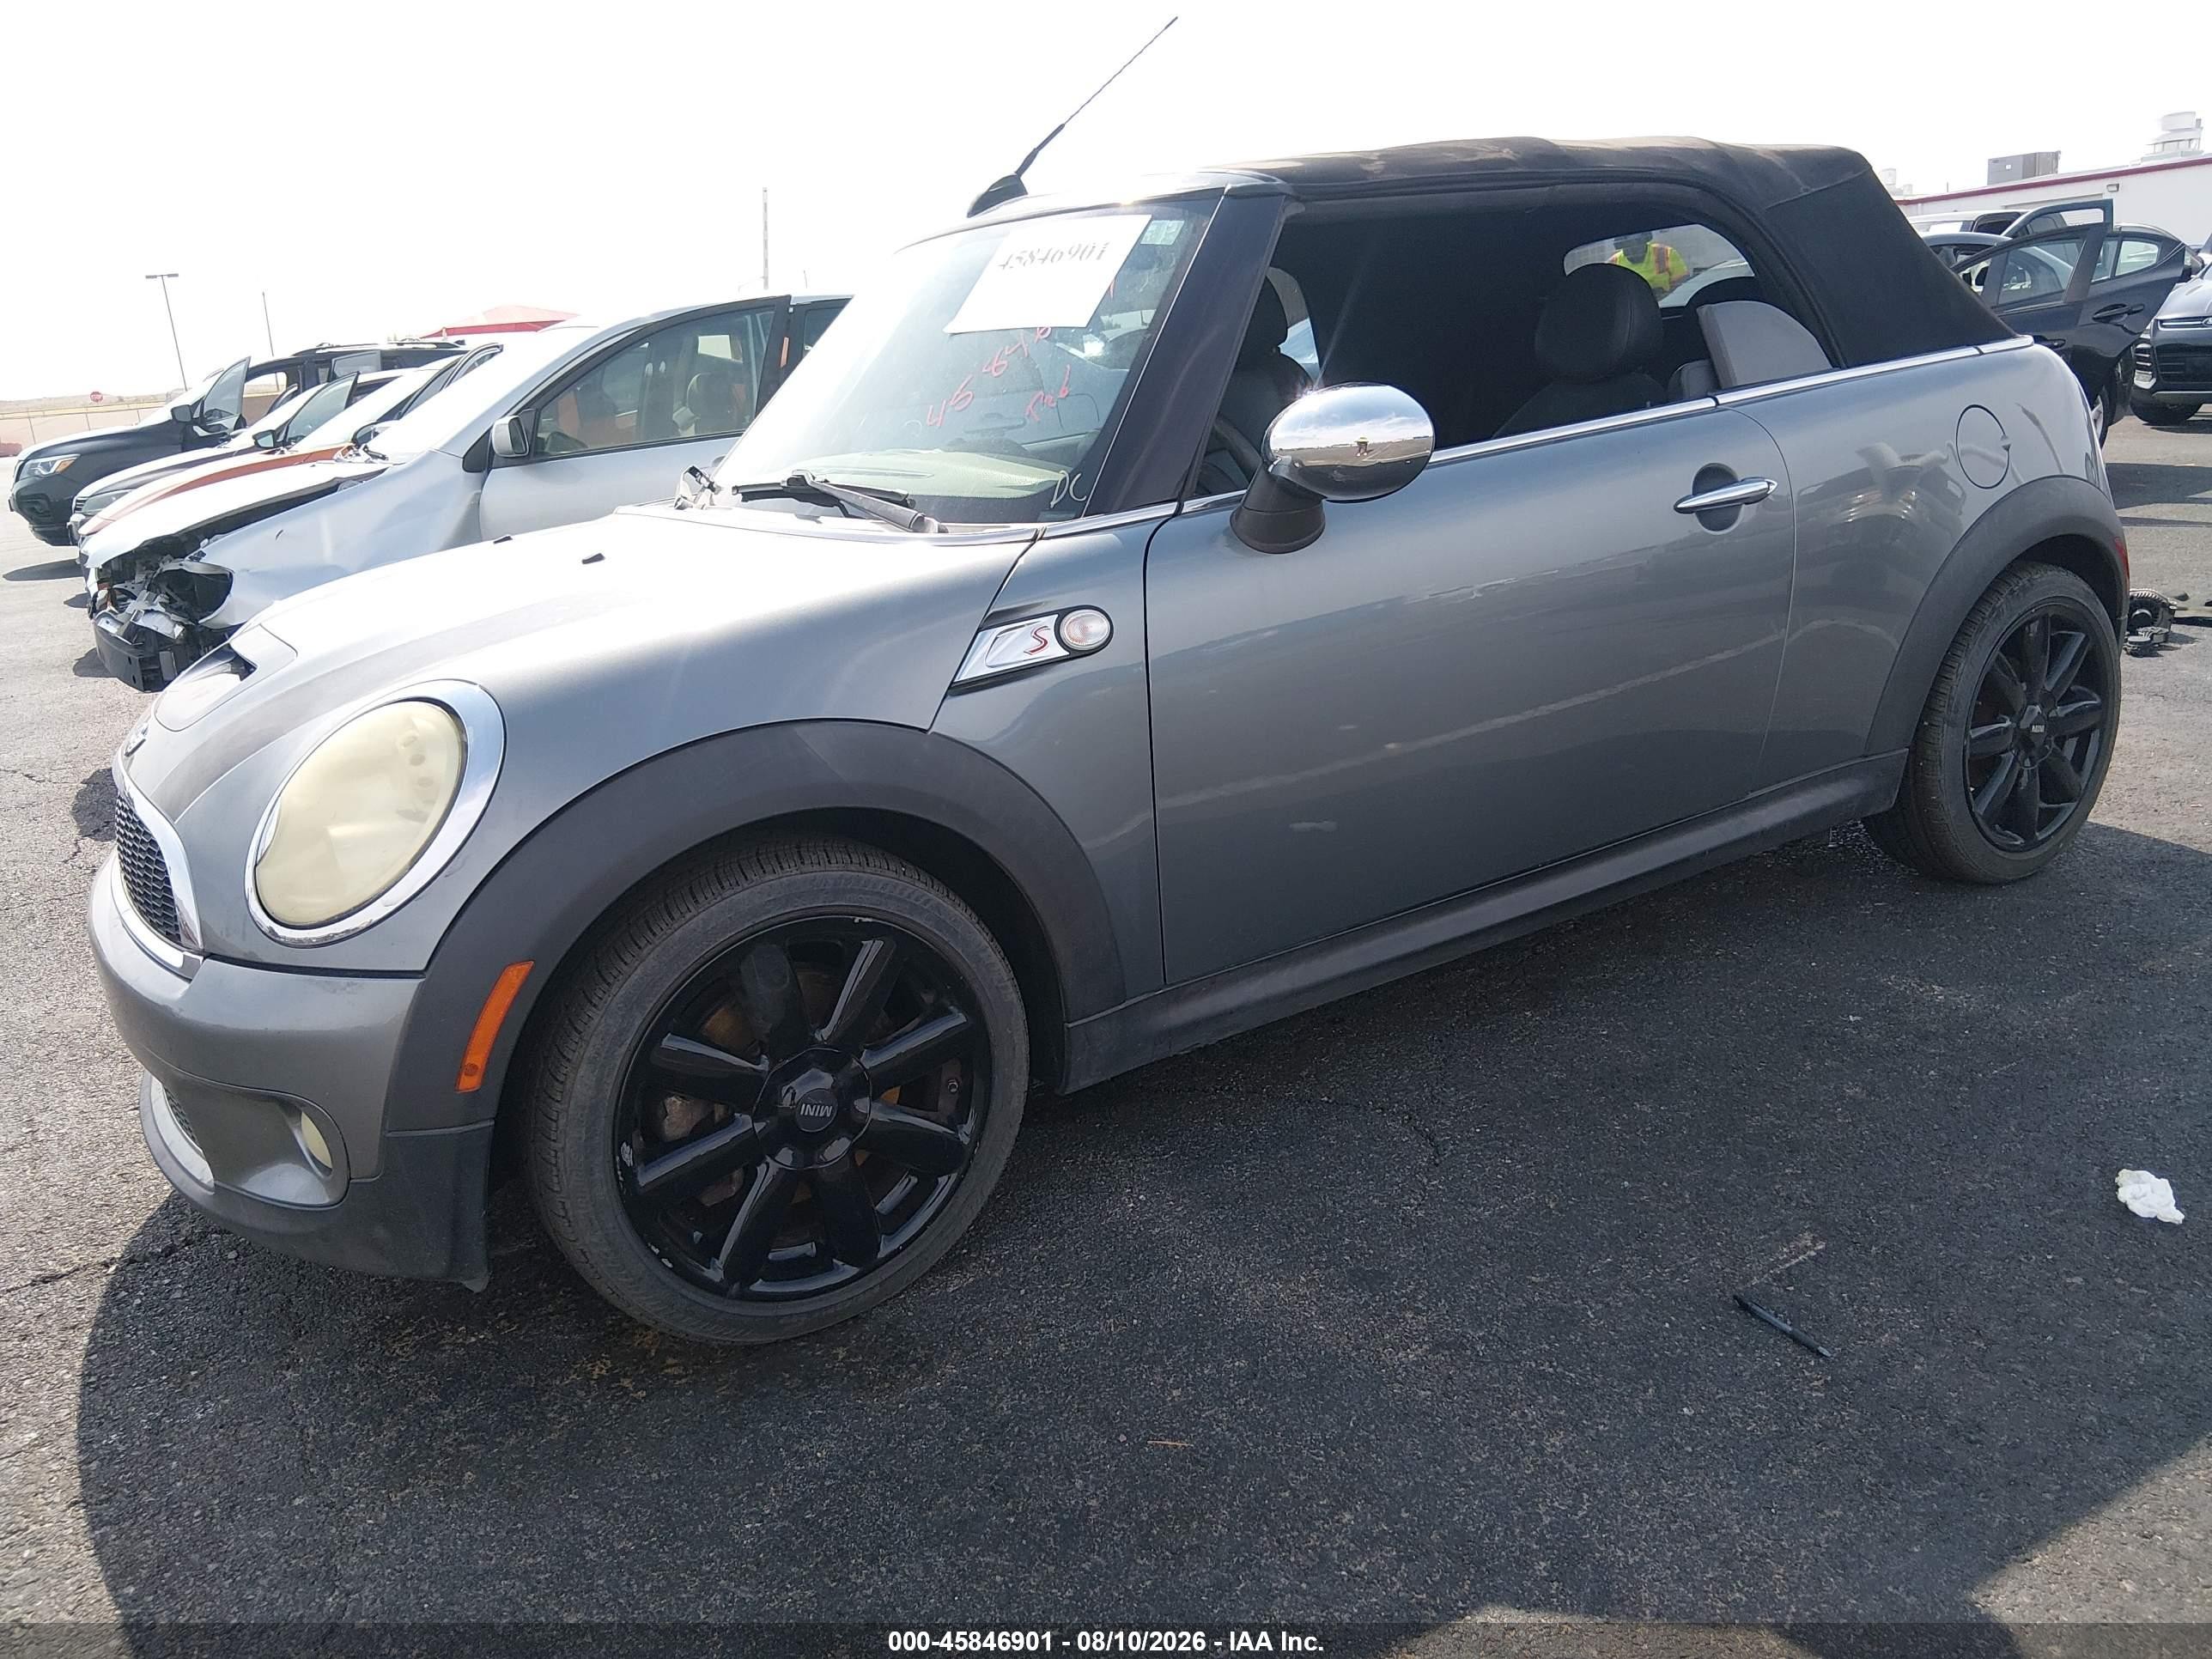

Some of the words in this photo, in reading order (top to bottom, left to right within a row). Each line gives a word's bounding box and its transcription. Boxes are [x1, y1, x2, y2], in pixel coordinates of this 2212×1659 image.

[1049, 470, 1087, 508] DC
[1024, 625, 1051, 656] S
[799, 1103, 834, 1117] MINI
